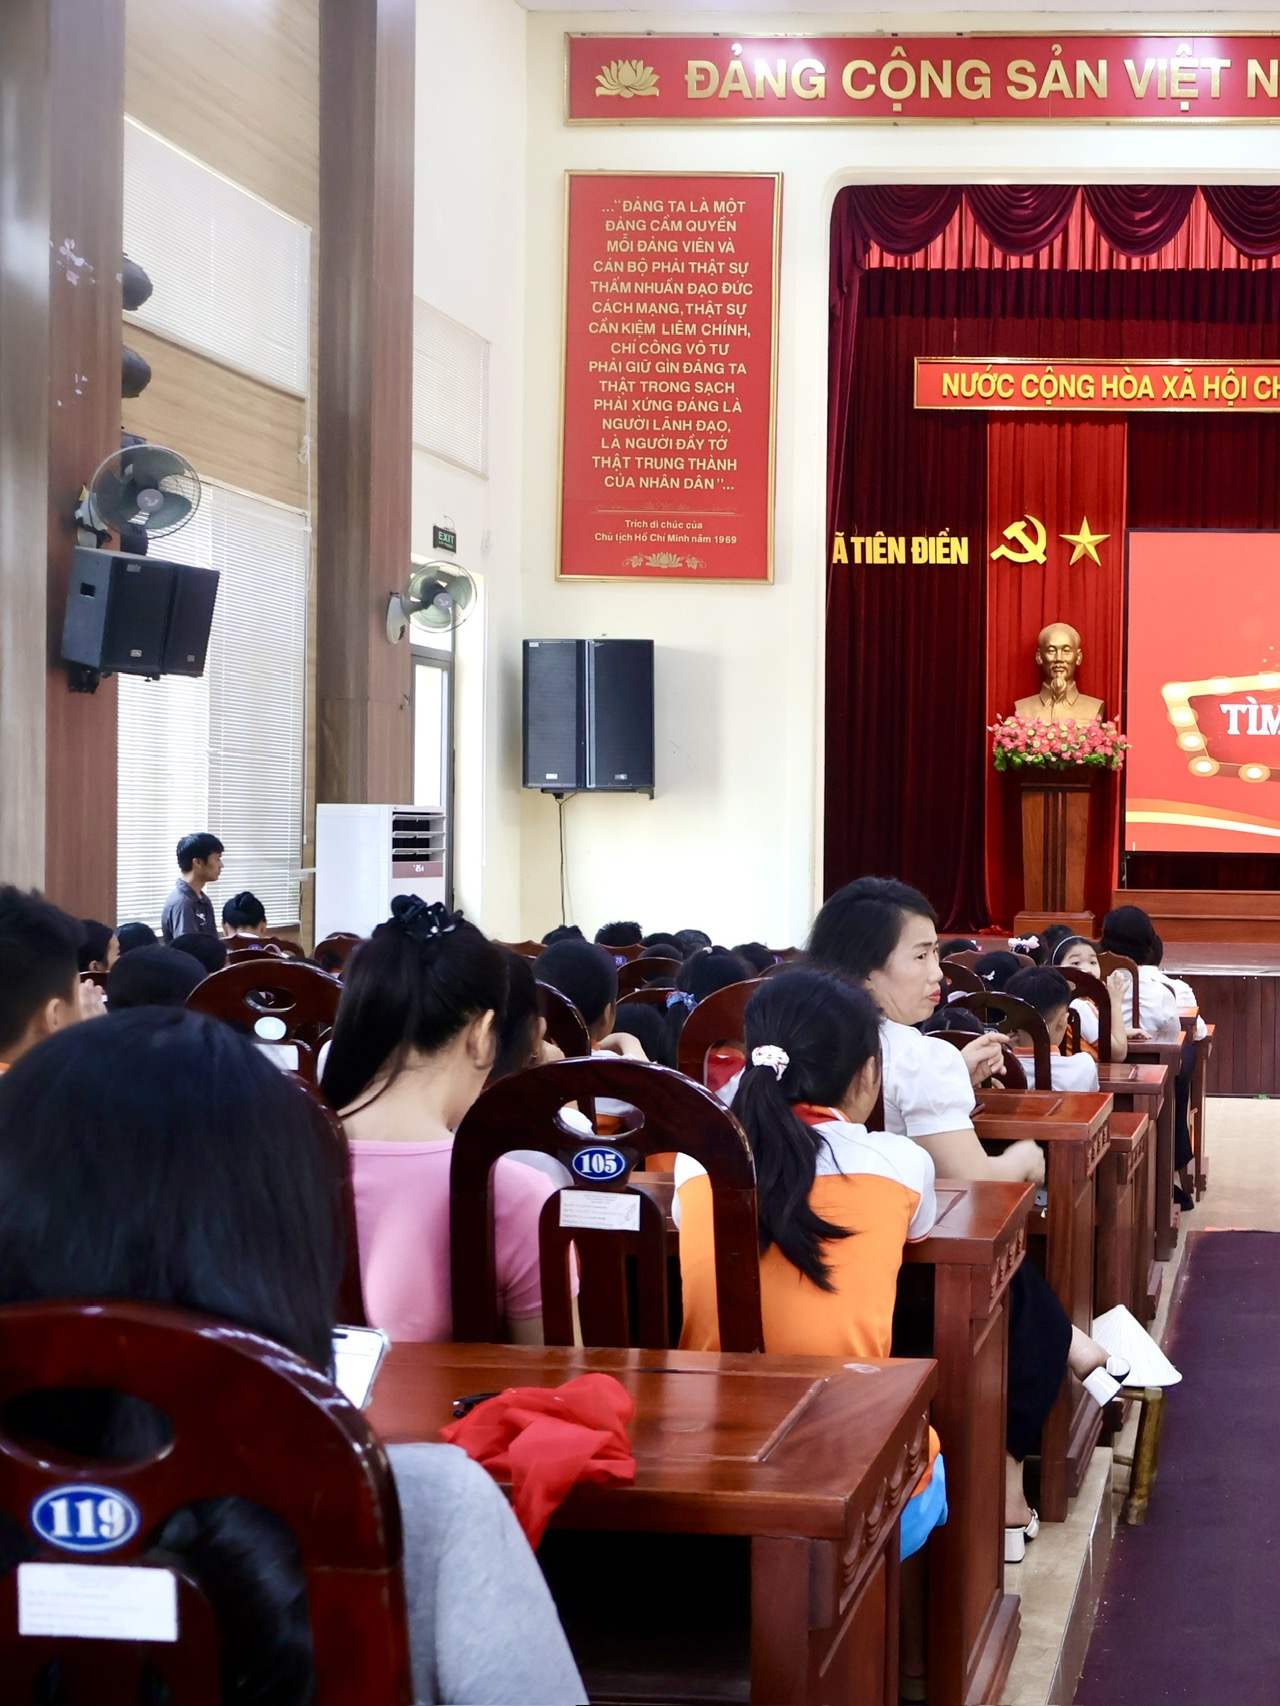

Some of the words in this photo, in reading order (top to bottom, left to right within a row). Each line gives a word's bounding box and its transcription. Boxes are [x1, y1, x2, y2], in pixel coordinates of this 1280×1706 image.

[686, 44, 826, 100] ĐẢNG
[841, 46, 992, 111] CỘNG
[1006, 44, 1108, 100] SẢN
[1123, 45, 1231, 111] VIỆT
[606, 216, 646, 231] ĐẢNG
[650, 215, 682, 231] CẦM
[686, 215, 736, 232] QUYỀN
[594, 258, 624, 272] CÁN
[628, 258, 648, 276] BỘ
[652, 258, 684, 273] PHẢI
[688, 259, 725, 276] THẬT
[729, 262, 749, 277] SỰ
[592, 299, 633, 313] CÁCH
[636, 303, 684, 317] MẠNG,
[686, 300, 723, 318] THẬT
[727, 304, 747, 319] SỰ
[611, 339, 636, 354] CHÍ
[638, 340, 682, 354] CÔNG
[686, 340, 706, 355] VÔ
[710, 344, 730, 355] TƯ
[589, 358, 622, 373] PHẢI
[626, 359, 651, 373] GIỮ
[656, 359, 679, 373] GÌN
[683, 359, 724, 374] ĐẢNG
[728, 363, 747, 374] TA
[942, 365, 1015, 399] NƯỚC
[1021, 366, 1095, 405] CỘNG
[1101, 367, 1155, 399] HÒA
[1161, 368, 1197, 400] XÃ
[1203, 367, 1247, 407] HỘI
[603, 415, 649, 430] NGƯỜI
[654, 416, 692, 431] LÃNH
[696, 420, 731, 434] ĐẠO,
[602, 434, 621, 449] LÀ
[626, 434, 673, 449] NGƯỜI
[708, 435, 728, 451] TỚ
[592, 453, 631, 471] THẬT
[635, 457, 684, 470] TRUNG
[688, 455, 737, 471] THÀNH
[661, 520, 684, 529] chúc
[438, 531, 454, 544] EXIT
[616, 533, 633, 544] tịch
[650, 533, 665, 542] Chí
[668, 534, 690, 542] Minh
[692, 534, 711, 543] năm
[714, 536, 737, 544] 1969
[832, 531, 849, 564] Ã
[850, 531, 906, 564] TIÊN
[911, 527, 969, 565] ĐIỀN
[580, 1153, 617, 1173] 105
[50, 1498, 126, 1539] 119
